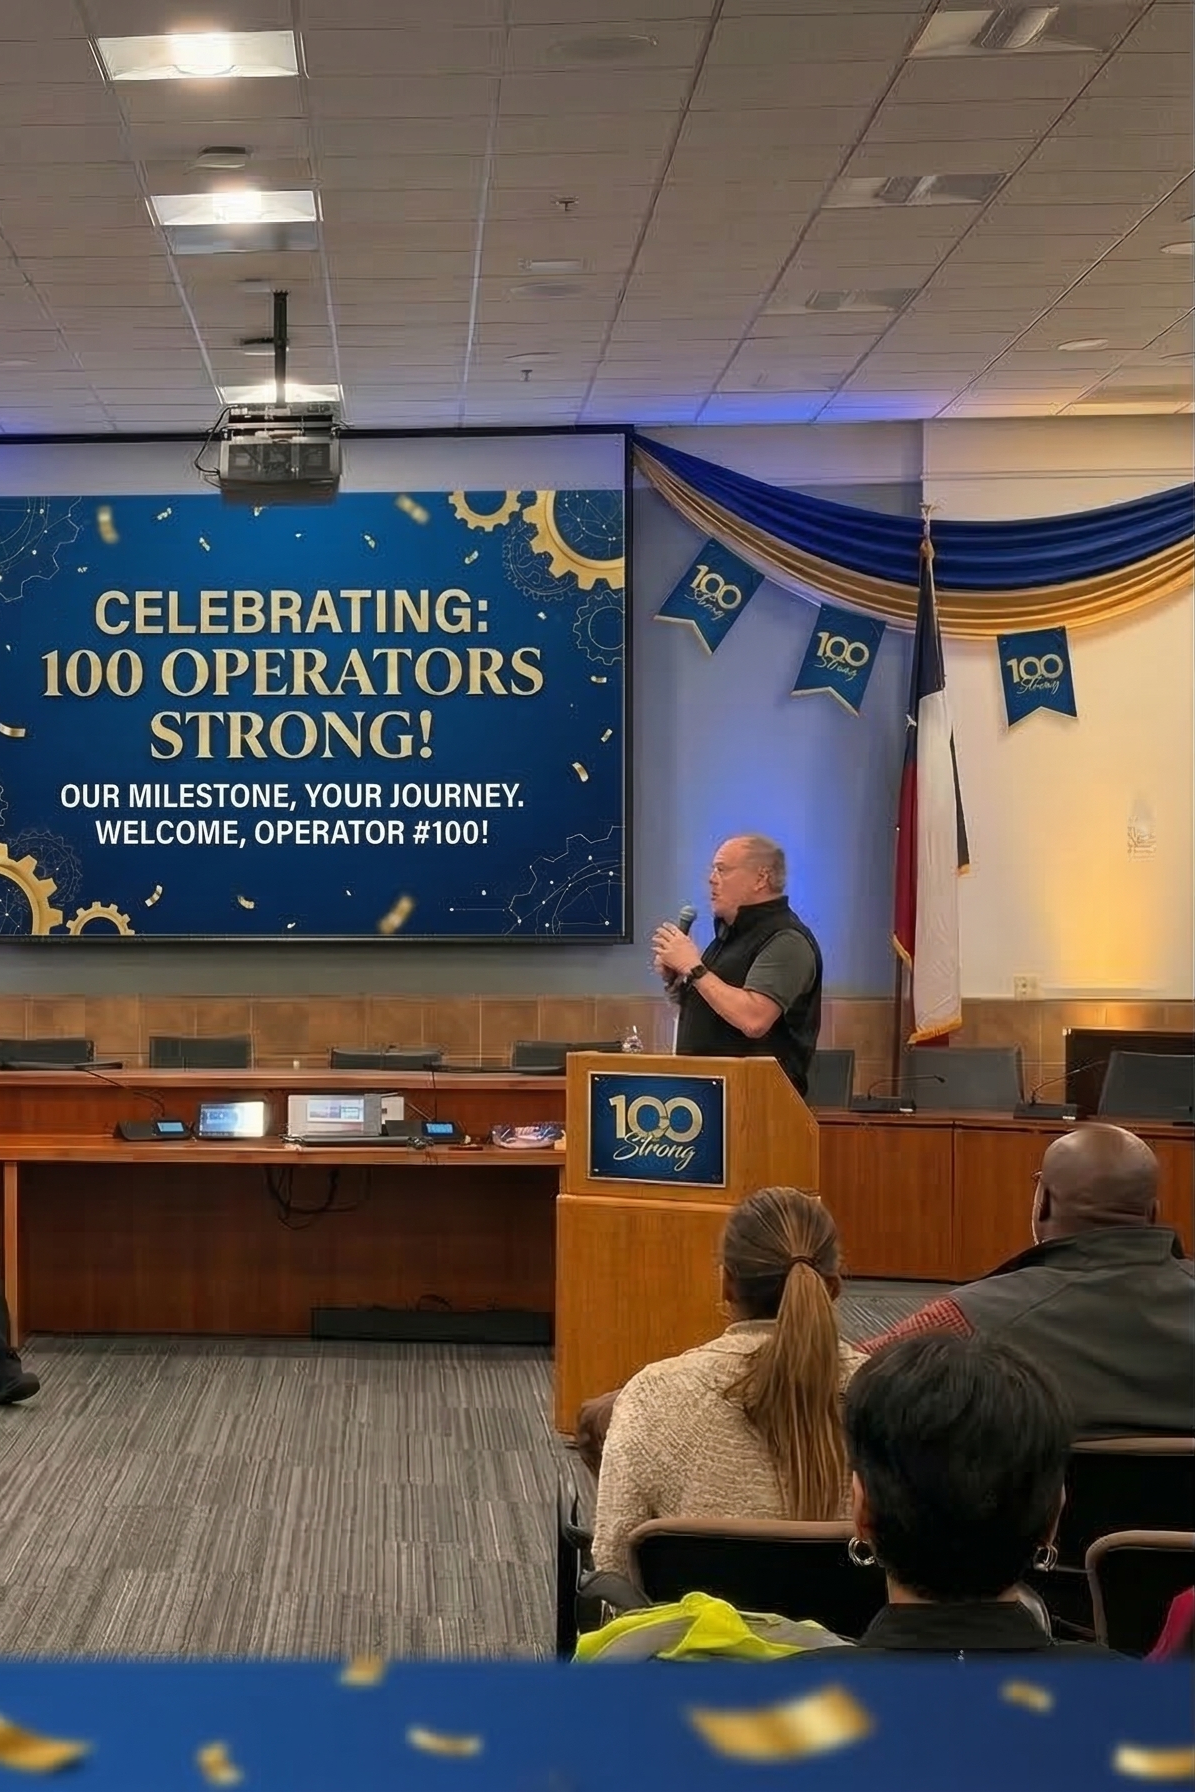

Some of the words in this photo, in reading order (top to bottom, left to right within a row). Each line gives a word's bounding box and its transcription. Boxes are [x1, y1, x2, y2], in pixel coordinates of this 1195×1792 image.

[689, 564, 743, 610] 100
[95, 588, 489, 635] CELEBRATING:
[816, 631, 870, 667] 100
[1005, 653, 1064, 683] 100
[41, 649, 144, 697] 100
[161, 647, 545, 697] OPERATORS
[149, 709, 434, 760] STRONG!
[60, 783, 120, 809] OUR
[129, 783, 297, 812] MILESTONE,
[304, 783, 382, 808] YOUR
[389, 783, 524, 808] JOURNEY.
[95, 819, 247, 849] WELCOME,
[254, 819, 405, 845] OPERATOR
[412, 819, 489, 845] #100!
[608, 1094, 703, 1143] 100
[613, 1131, 696, 1172] Strong
